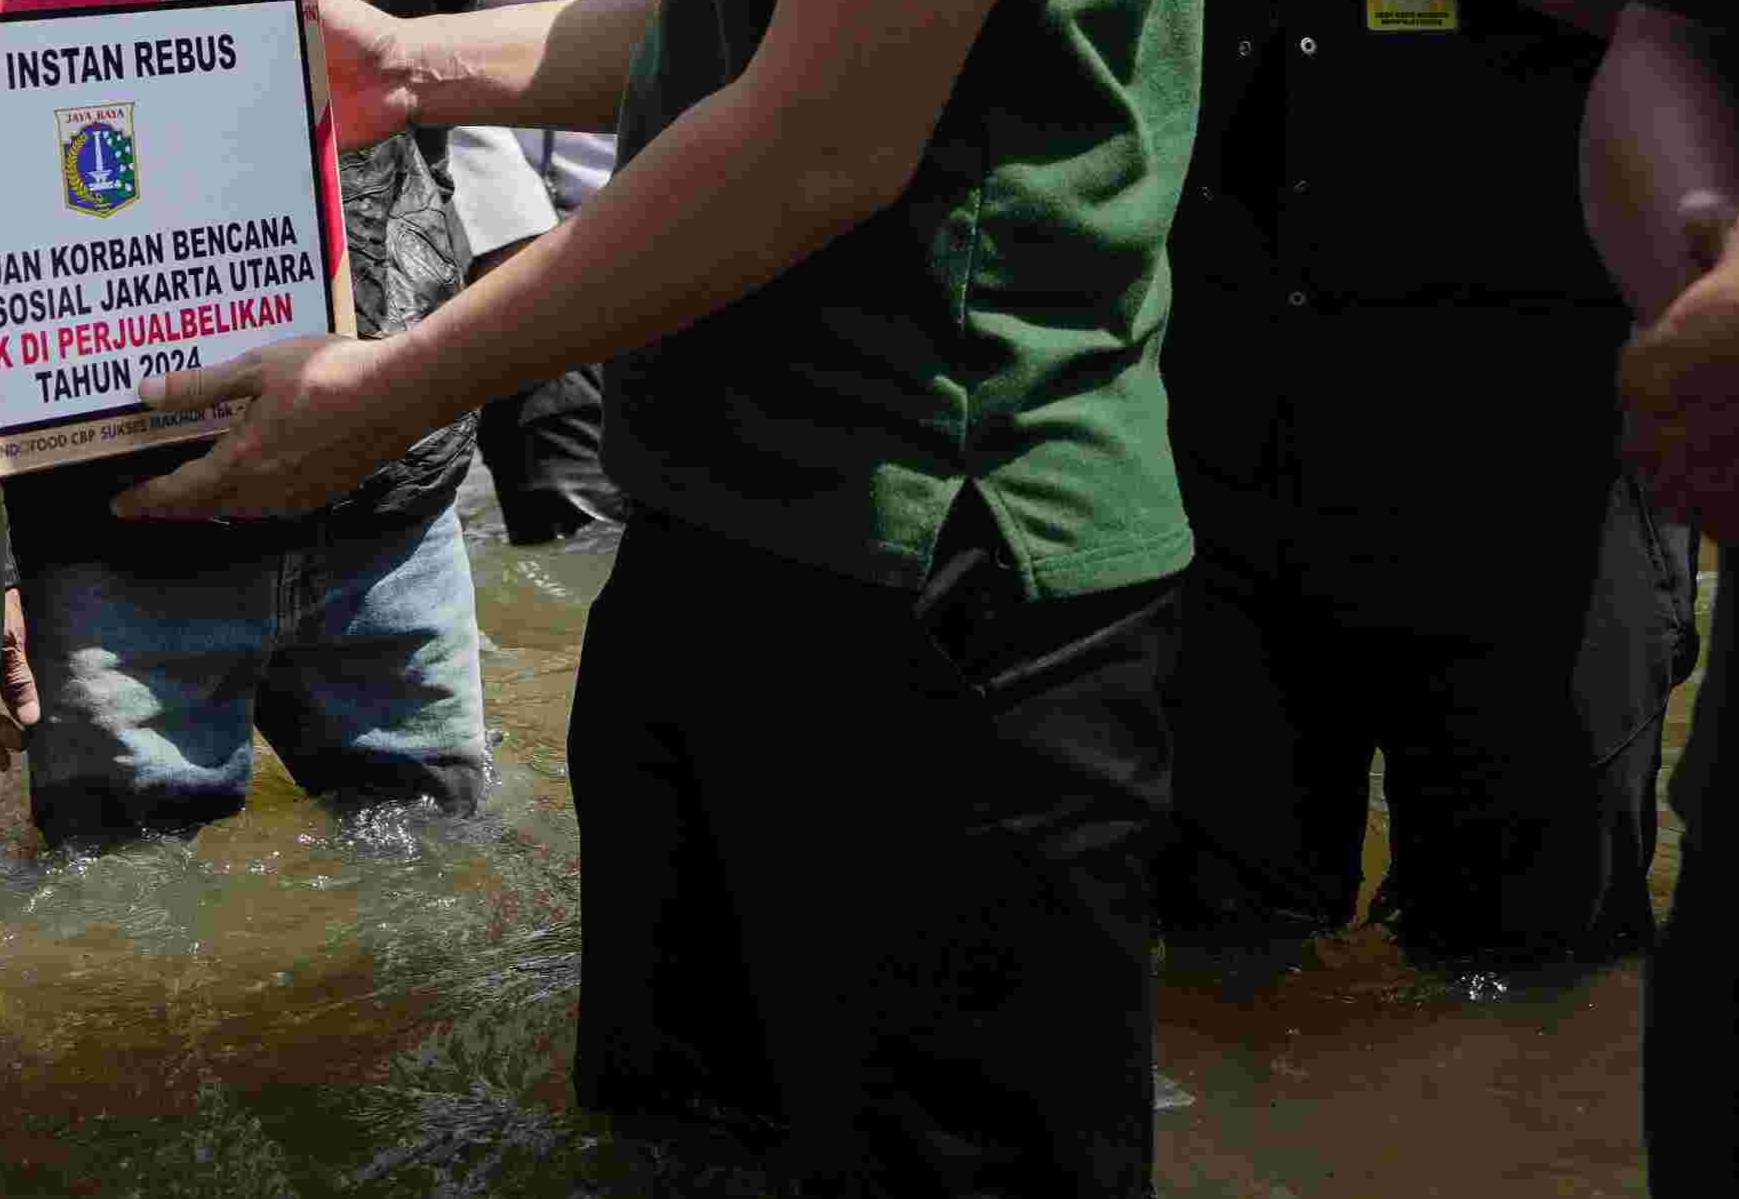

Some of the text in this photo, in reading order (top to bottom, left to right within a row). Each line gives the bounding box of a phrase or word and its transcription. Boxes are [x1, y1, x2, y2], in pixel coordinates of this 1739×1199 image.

[6, 43, 124, 90] INSTAN
[134, 33, 237, 78] REBUS
[66, 108, 124, 123] JAYA RAYA
[50, 233, 164, 279] KORBAN
[172, 216, 297, 261] BENCANA
[100, 265, 223, 312] JAKARTA
[229, 251, 315, 292] UTARA
[20, 331, 49, 365] DI
[58, 292, 293, 359] PERJUALBELIKAN
[36, 347, 202, 403] TAHUN 2024
[71, 429, 96, 445] CBP
[100, 418, 148, 438] SUKSES
